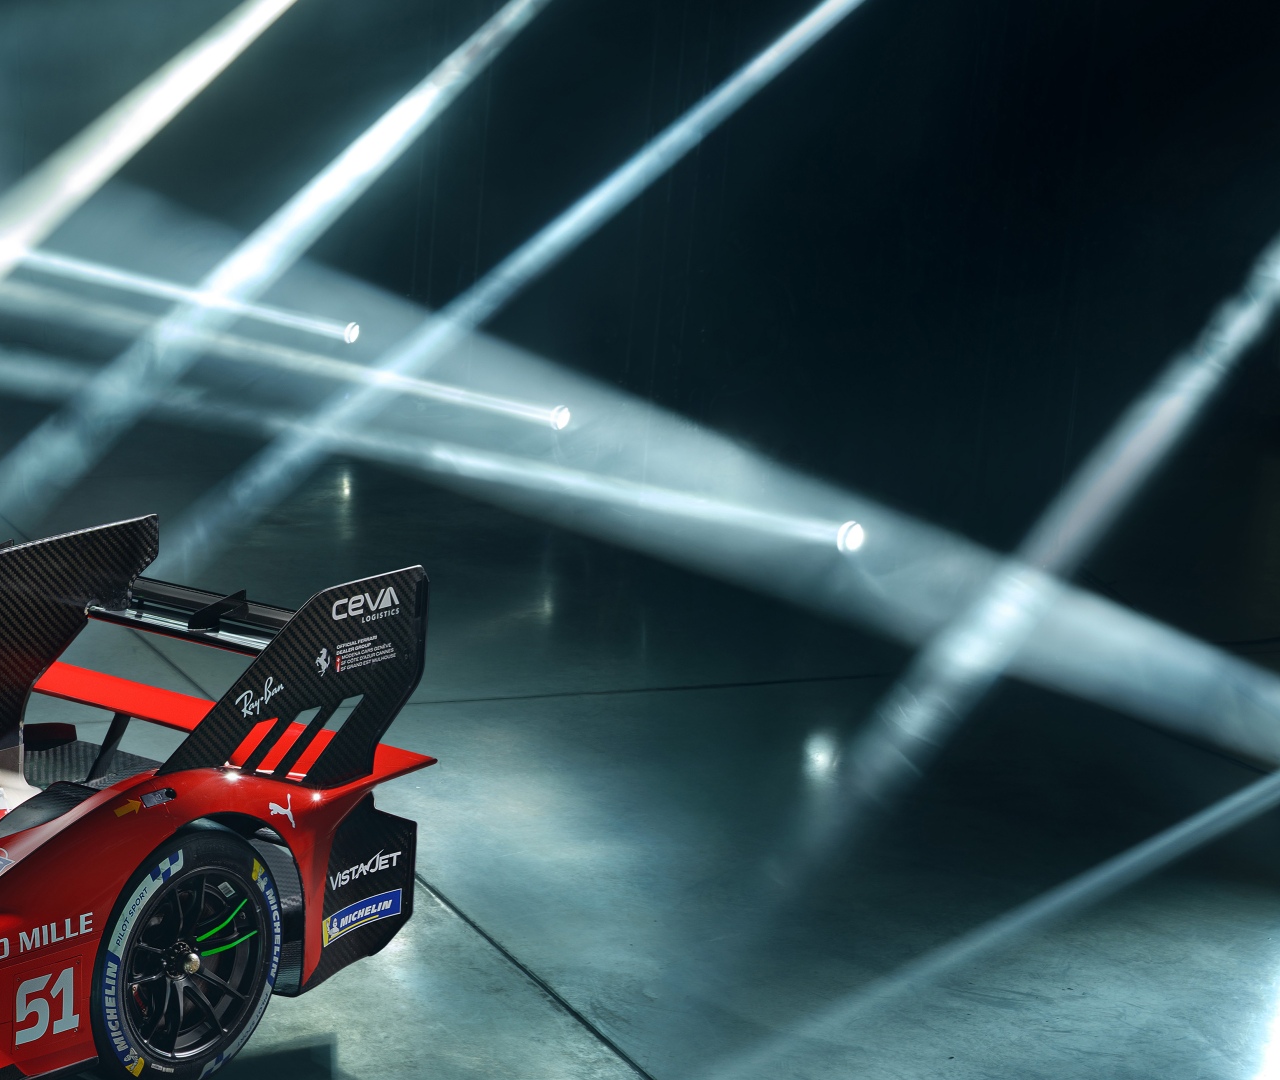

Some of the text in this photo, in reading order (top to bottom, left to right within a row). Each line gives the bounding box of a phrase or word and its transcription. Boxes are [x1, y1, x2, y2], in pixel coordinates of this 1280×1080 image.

[362, 608, 400, 623] LOGISTICS
[336, 635, 378, 650] OFFICIAL FERRARI
[336, 642, 372, 656] DEALER GROUP
[329, 849, 402, 891] VISTAJET
[19, 912, 94, 951] MILLE
[115, 887, 148, 946] PILOT SPORT
[266, 888, 282, 978] MICHELIN
[339, 899, 393, 928] MICHELIN
[15, 967, 80, 1046] 51
[104, 961, 129, 1052] MICHELIN
